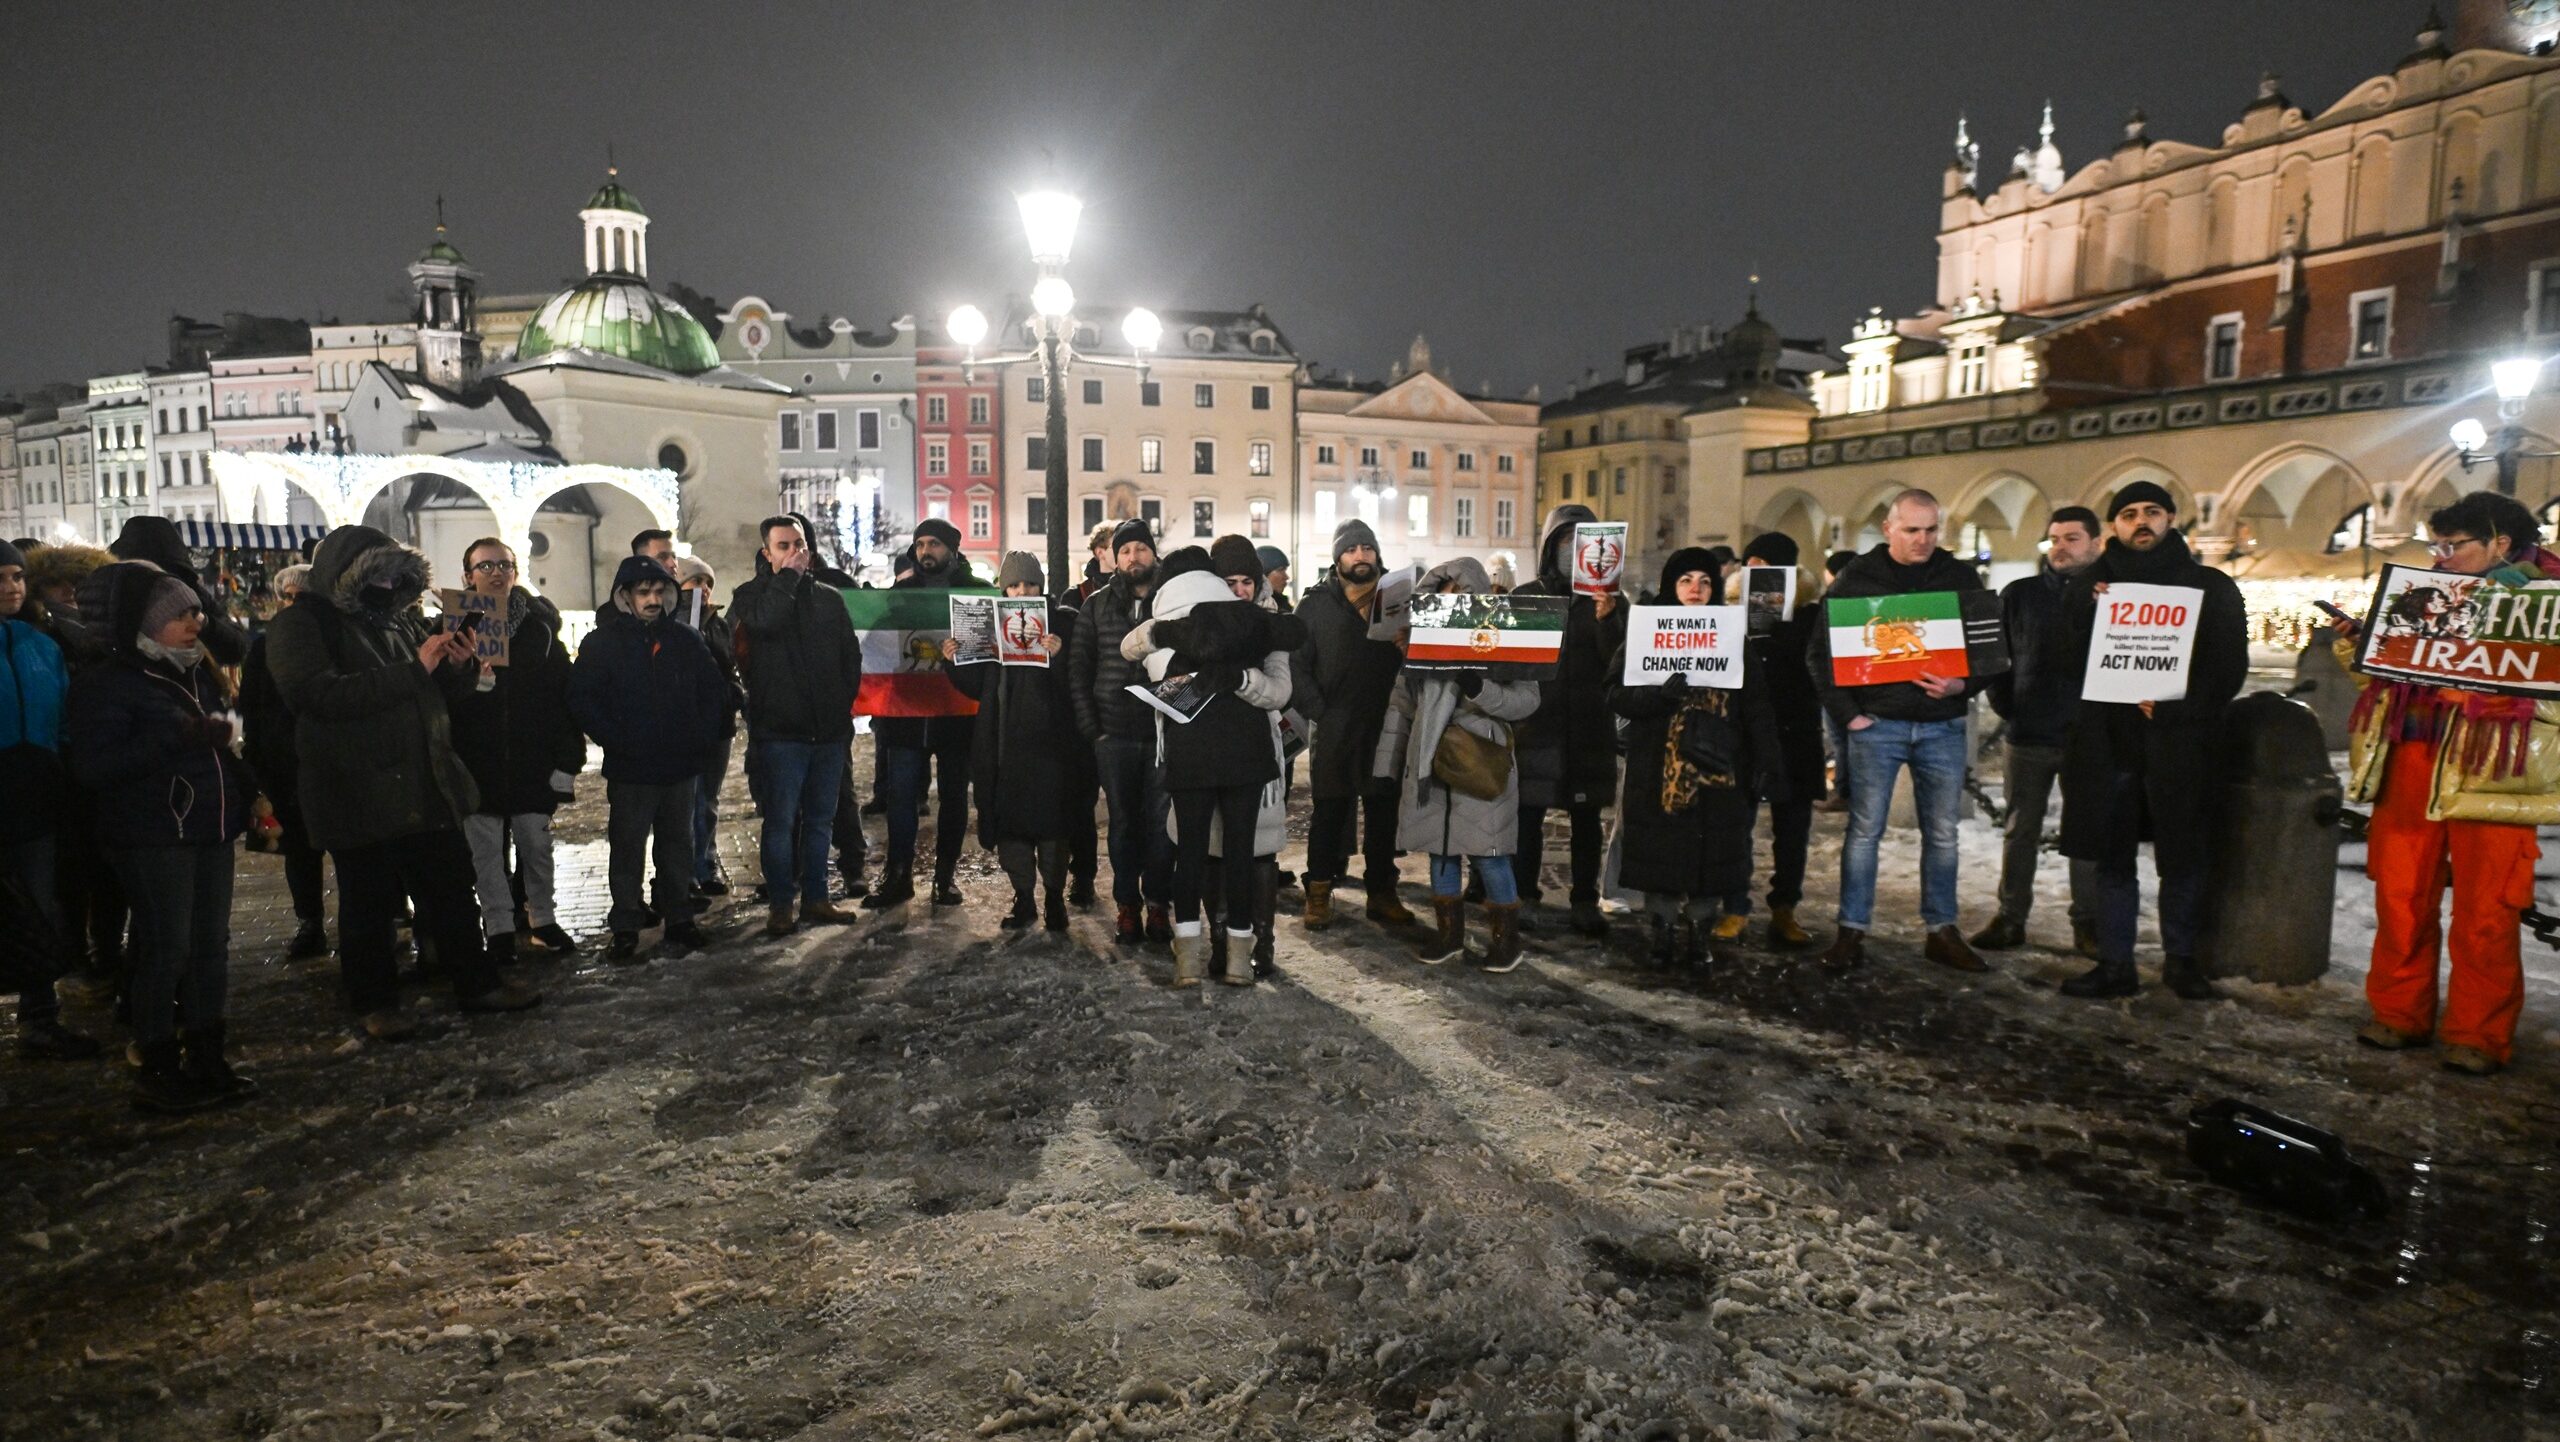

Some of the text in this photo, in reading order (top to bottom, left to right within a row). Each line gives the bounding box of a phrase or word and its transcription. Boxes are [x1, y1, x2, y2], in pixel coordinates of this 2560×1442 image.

[458, 594, 497, 612] ZAN
[2109, 602, 2187, 627] 12,000
[1657, 618, 1717, 630] WE WANT A
[1654, 632, 1718, 650] REGIME
[2105, 633, 2131, 642] People
[2151, 634, 2180, 643] brutally
[2135, 643, 2149, 651] this
[1642, 656, 1729, 672] CHANGE NOW
[2100, 654, 2179, 672] ACT NOW!
[2410, 638, 2540, 680] IRAN
